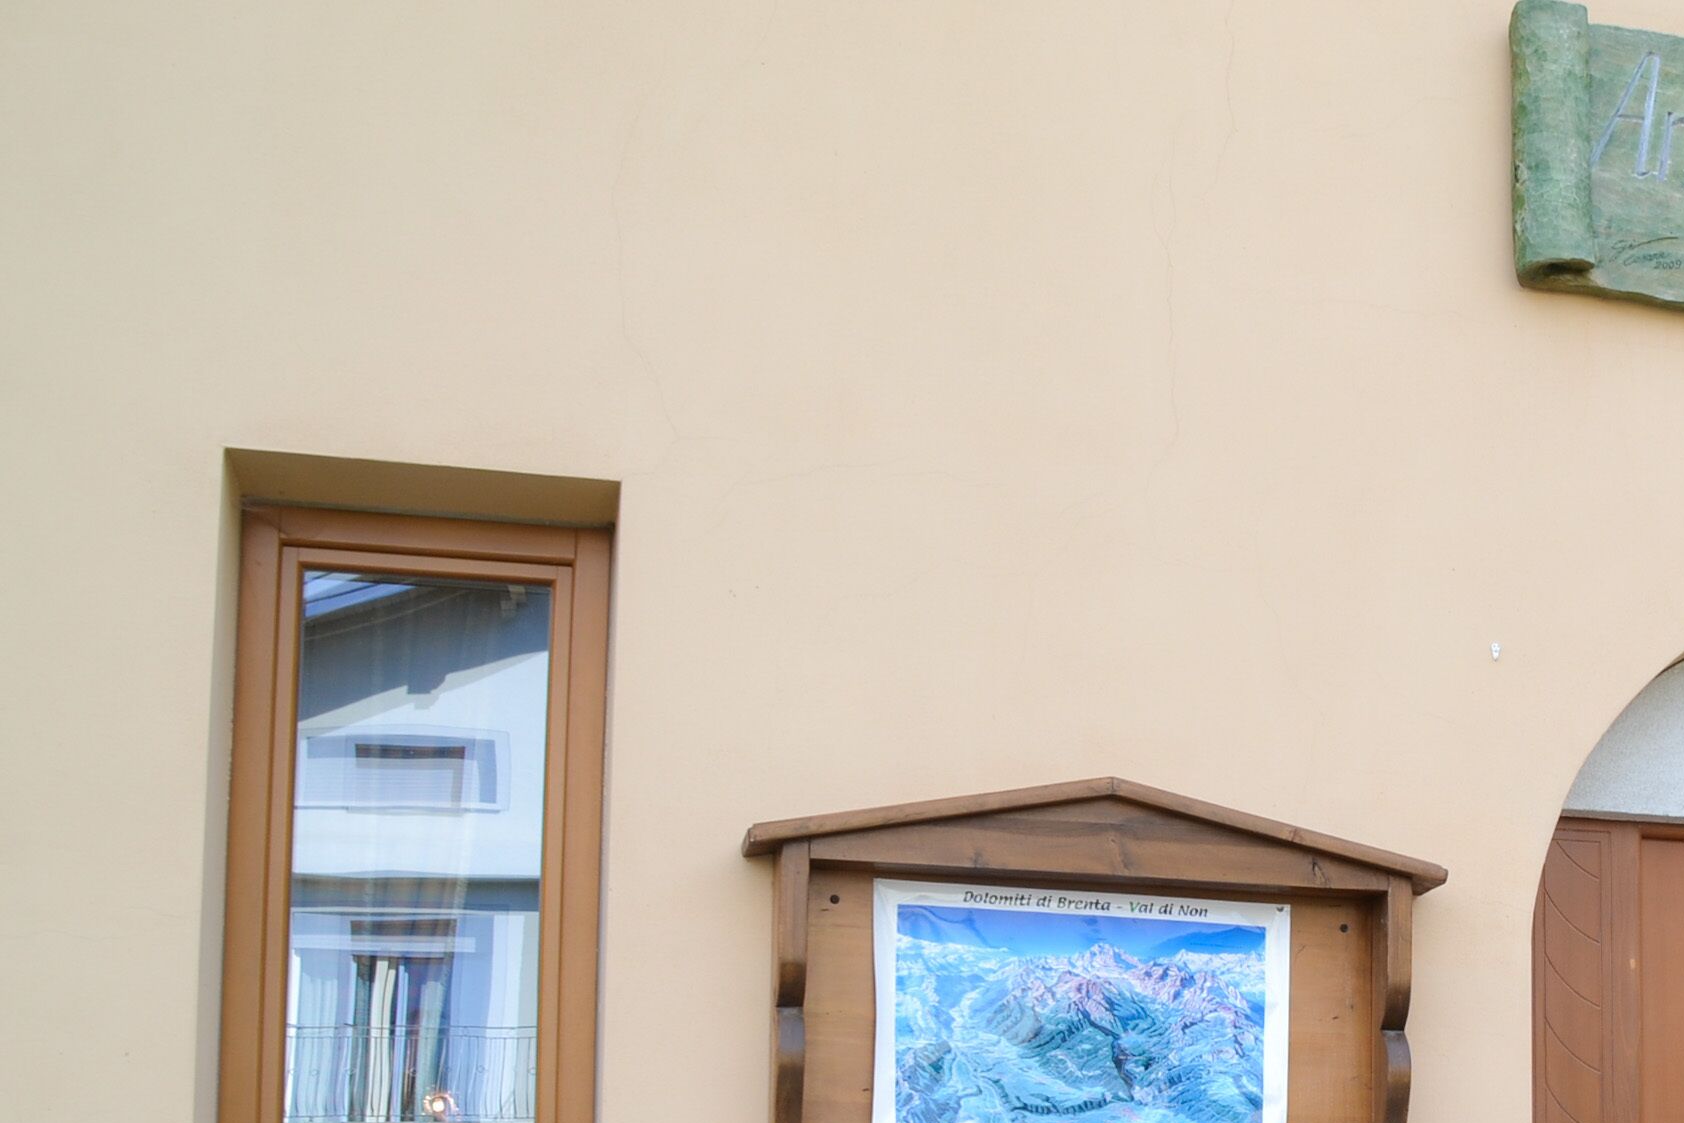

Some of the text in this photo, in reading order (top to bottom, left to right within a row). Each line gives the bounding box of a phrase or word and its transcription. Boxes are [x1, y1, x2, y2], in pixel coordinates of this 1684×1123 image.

[1653, 259, 1682, 270] 2009
[962, 889, 1033, 907] Dolomiti
[1036, 894, 1053, 908] di
[1056, 895, 1112, 912] Brenta
[1128, 899, 1154, 915] Val
[1157, 902, 1174, 917] di
[1178, 903, 1209, 918] Non
